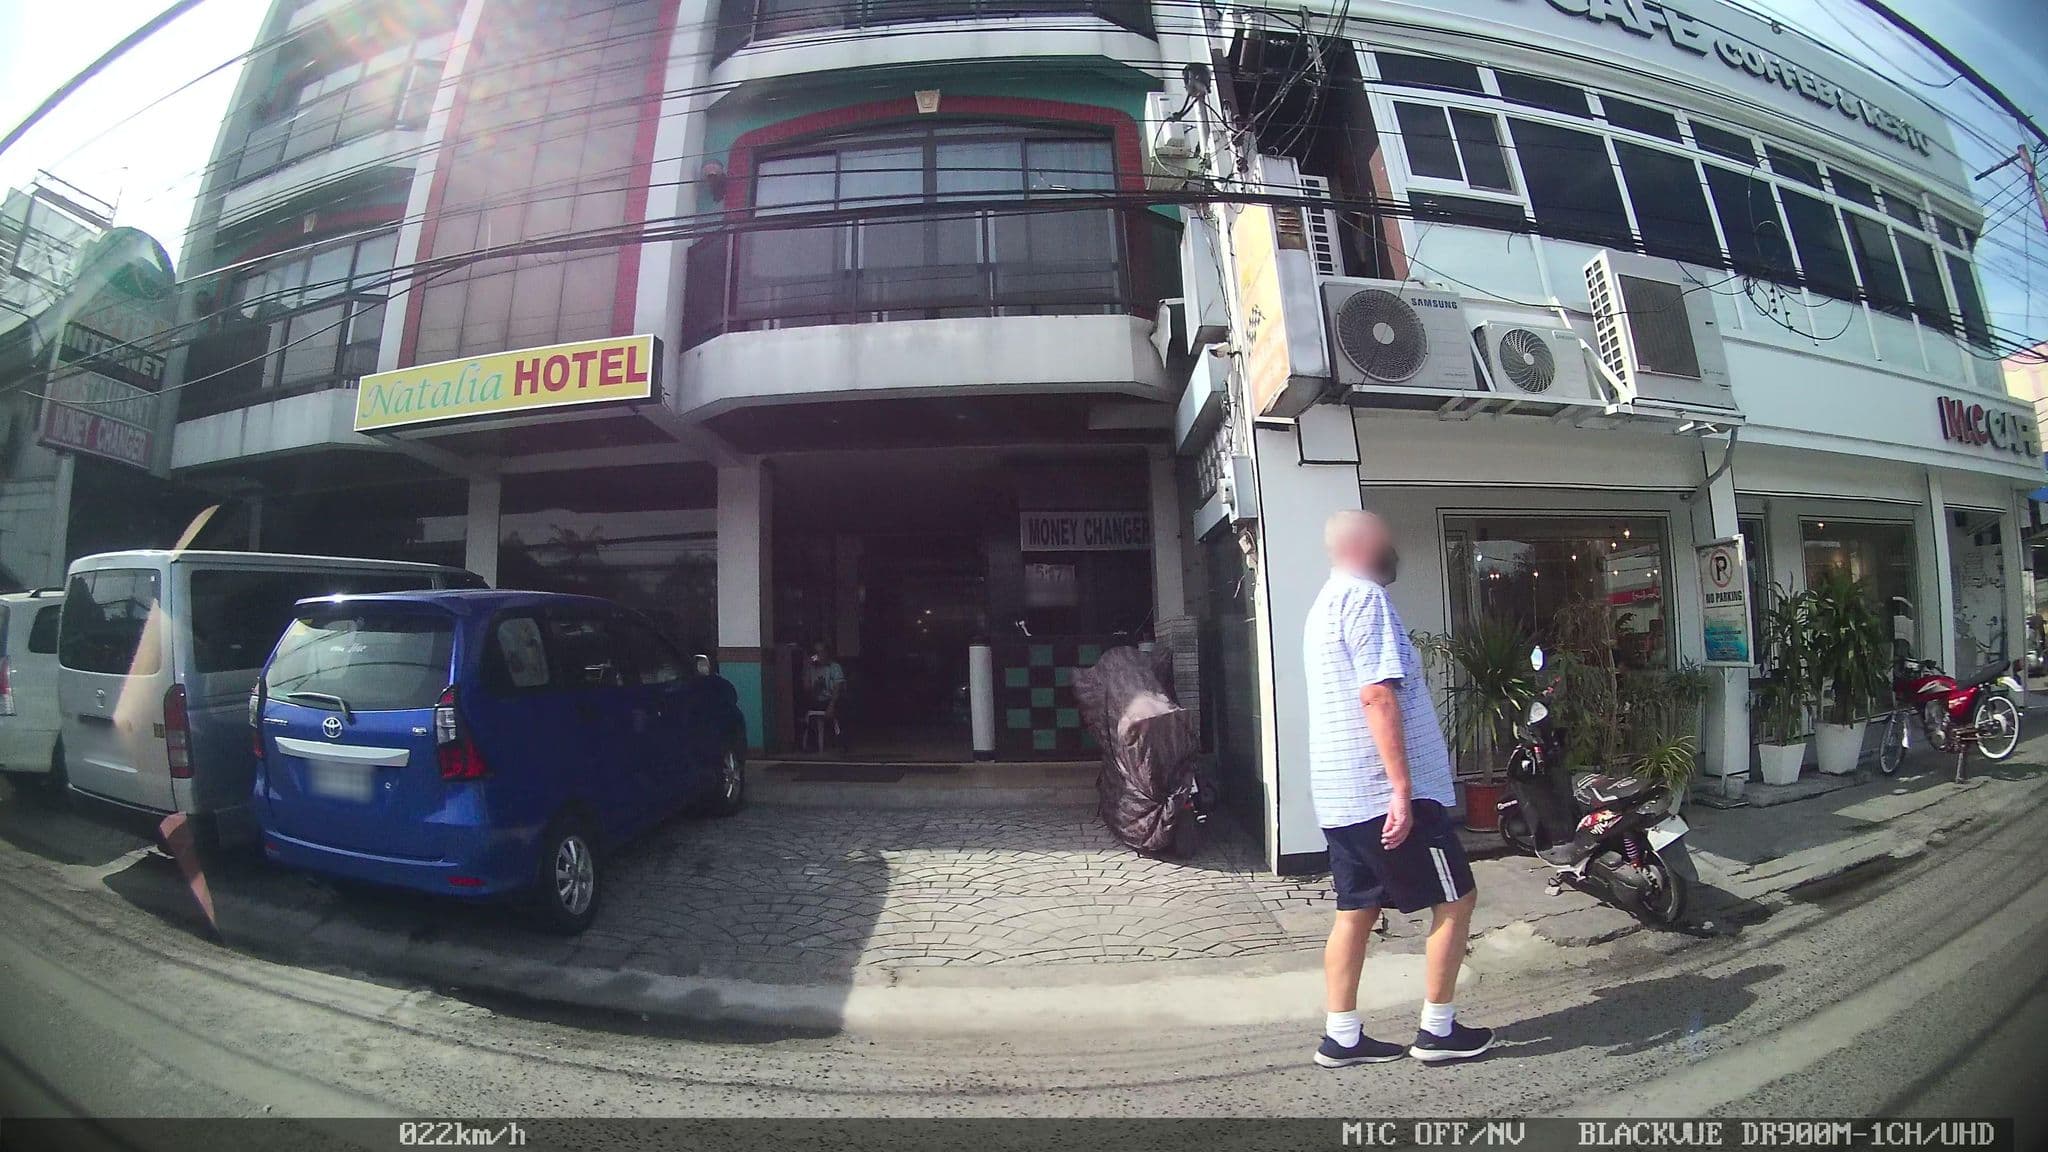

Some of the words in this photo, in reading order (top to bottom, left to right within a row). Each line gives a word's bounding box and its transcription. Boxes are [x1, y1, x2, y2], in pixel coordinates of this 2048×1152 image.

[1714, 36, 1836, 109] COFFEE
[1411, 297, 1458, 309] SAMSUNG
[362, 362, 503, 418] Natalia
[514, 345, 648, 396] HOTEL
[1029, 518, 1078, 545] MONEY
